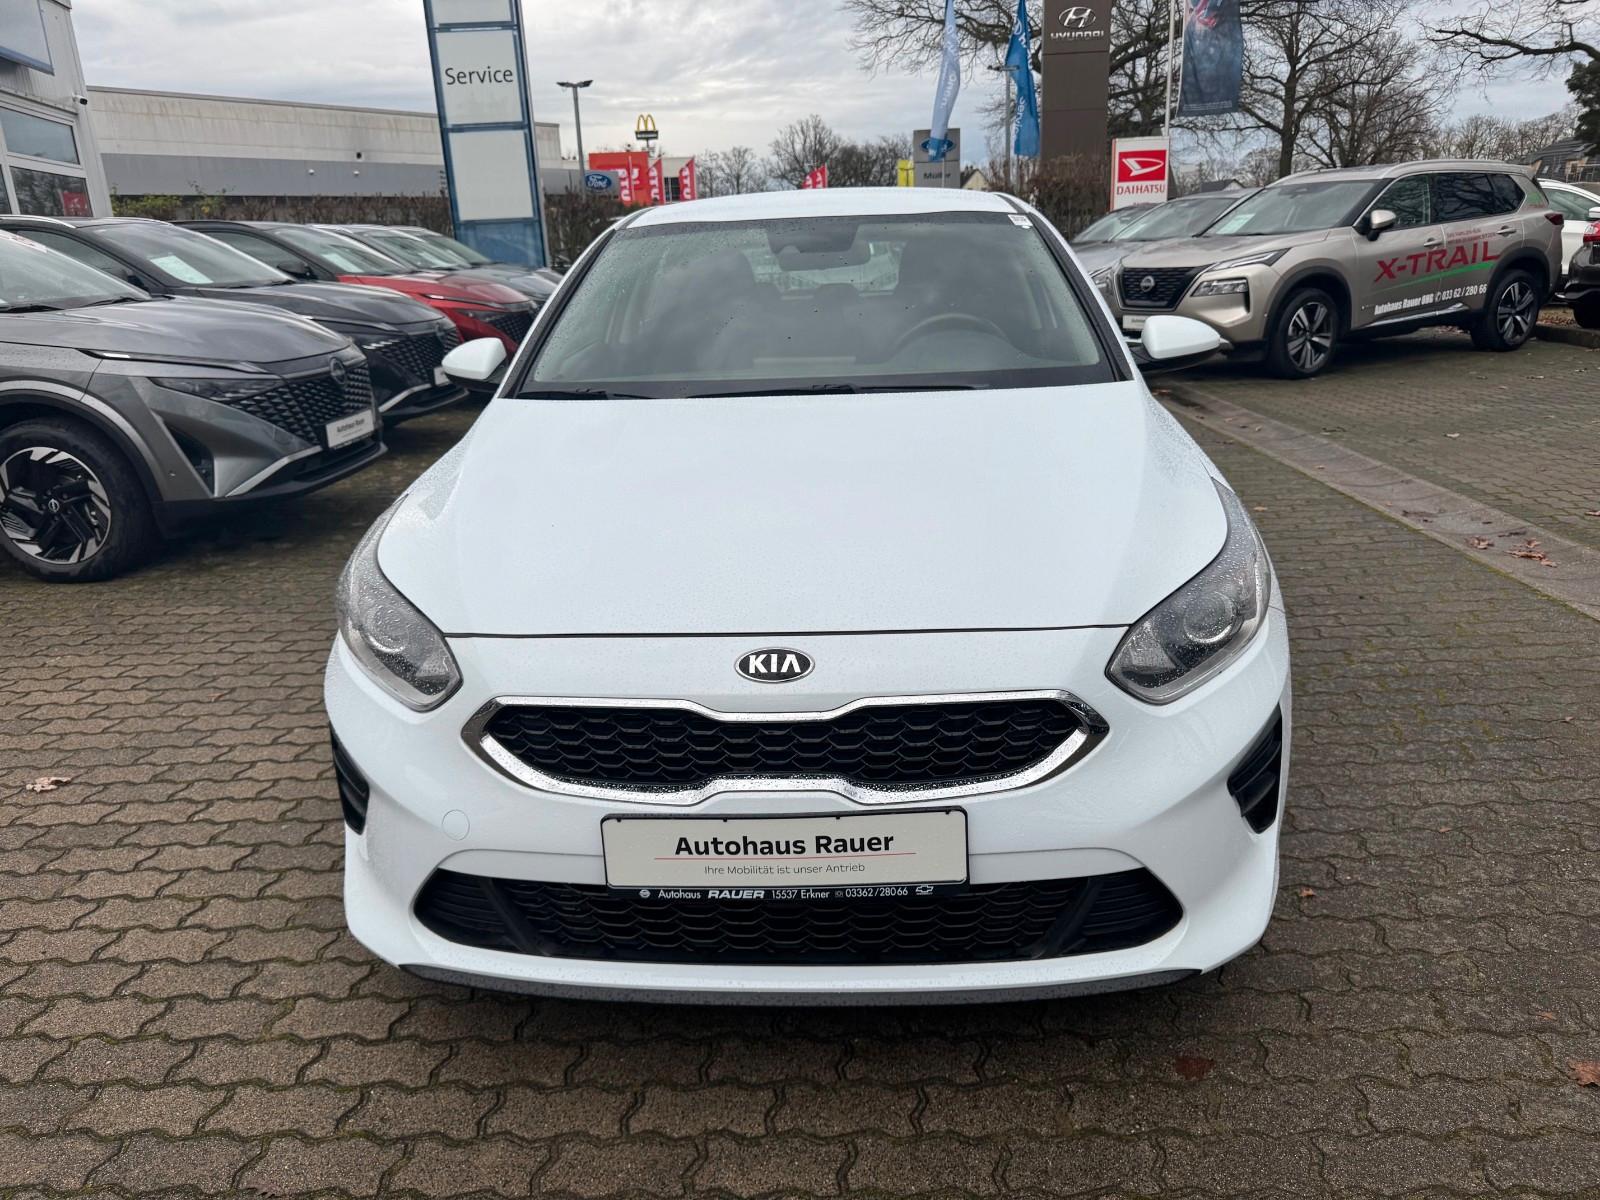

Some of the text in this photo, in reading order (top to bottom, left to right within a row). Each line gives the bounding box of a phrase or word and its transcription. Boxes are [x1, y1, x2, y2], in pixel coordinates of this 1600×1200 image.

[444, 65, 514, 86] Service
[587, 174, 608, 189] Ford
[1116, 184, 1166, 195] DAIHATSU
[1374, 240, 1500, 283] X-TRAIL
[1374, 301, 1402, 315] Autohaus
[1402, 297, 1421, 308] Rauer
[748, 654, 802, 674] KIA
[674, 835, 894, 856] Autohaus Rauer
[704, 862, 866, 875] Ihre Mobilität ist unser Antrieb
[658, 887, 909, 899] Autohaus RAUER 15537 Erkner 03362/28066
